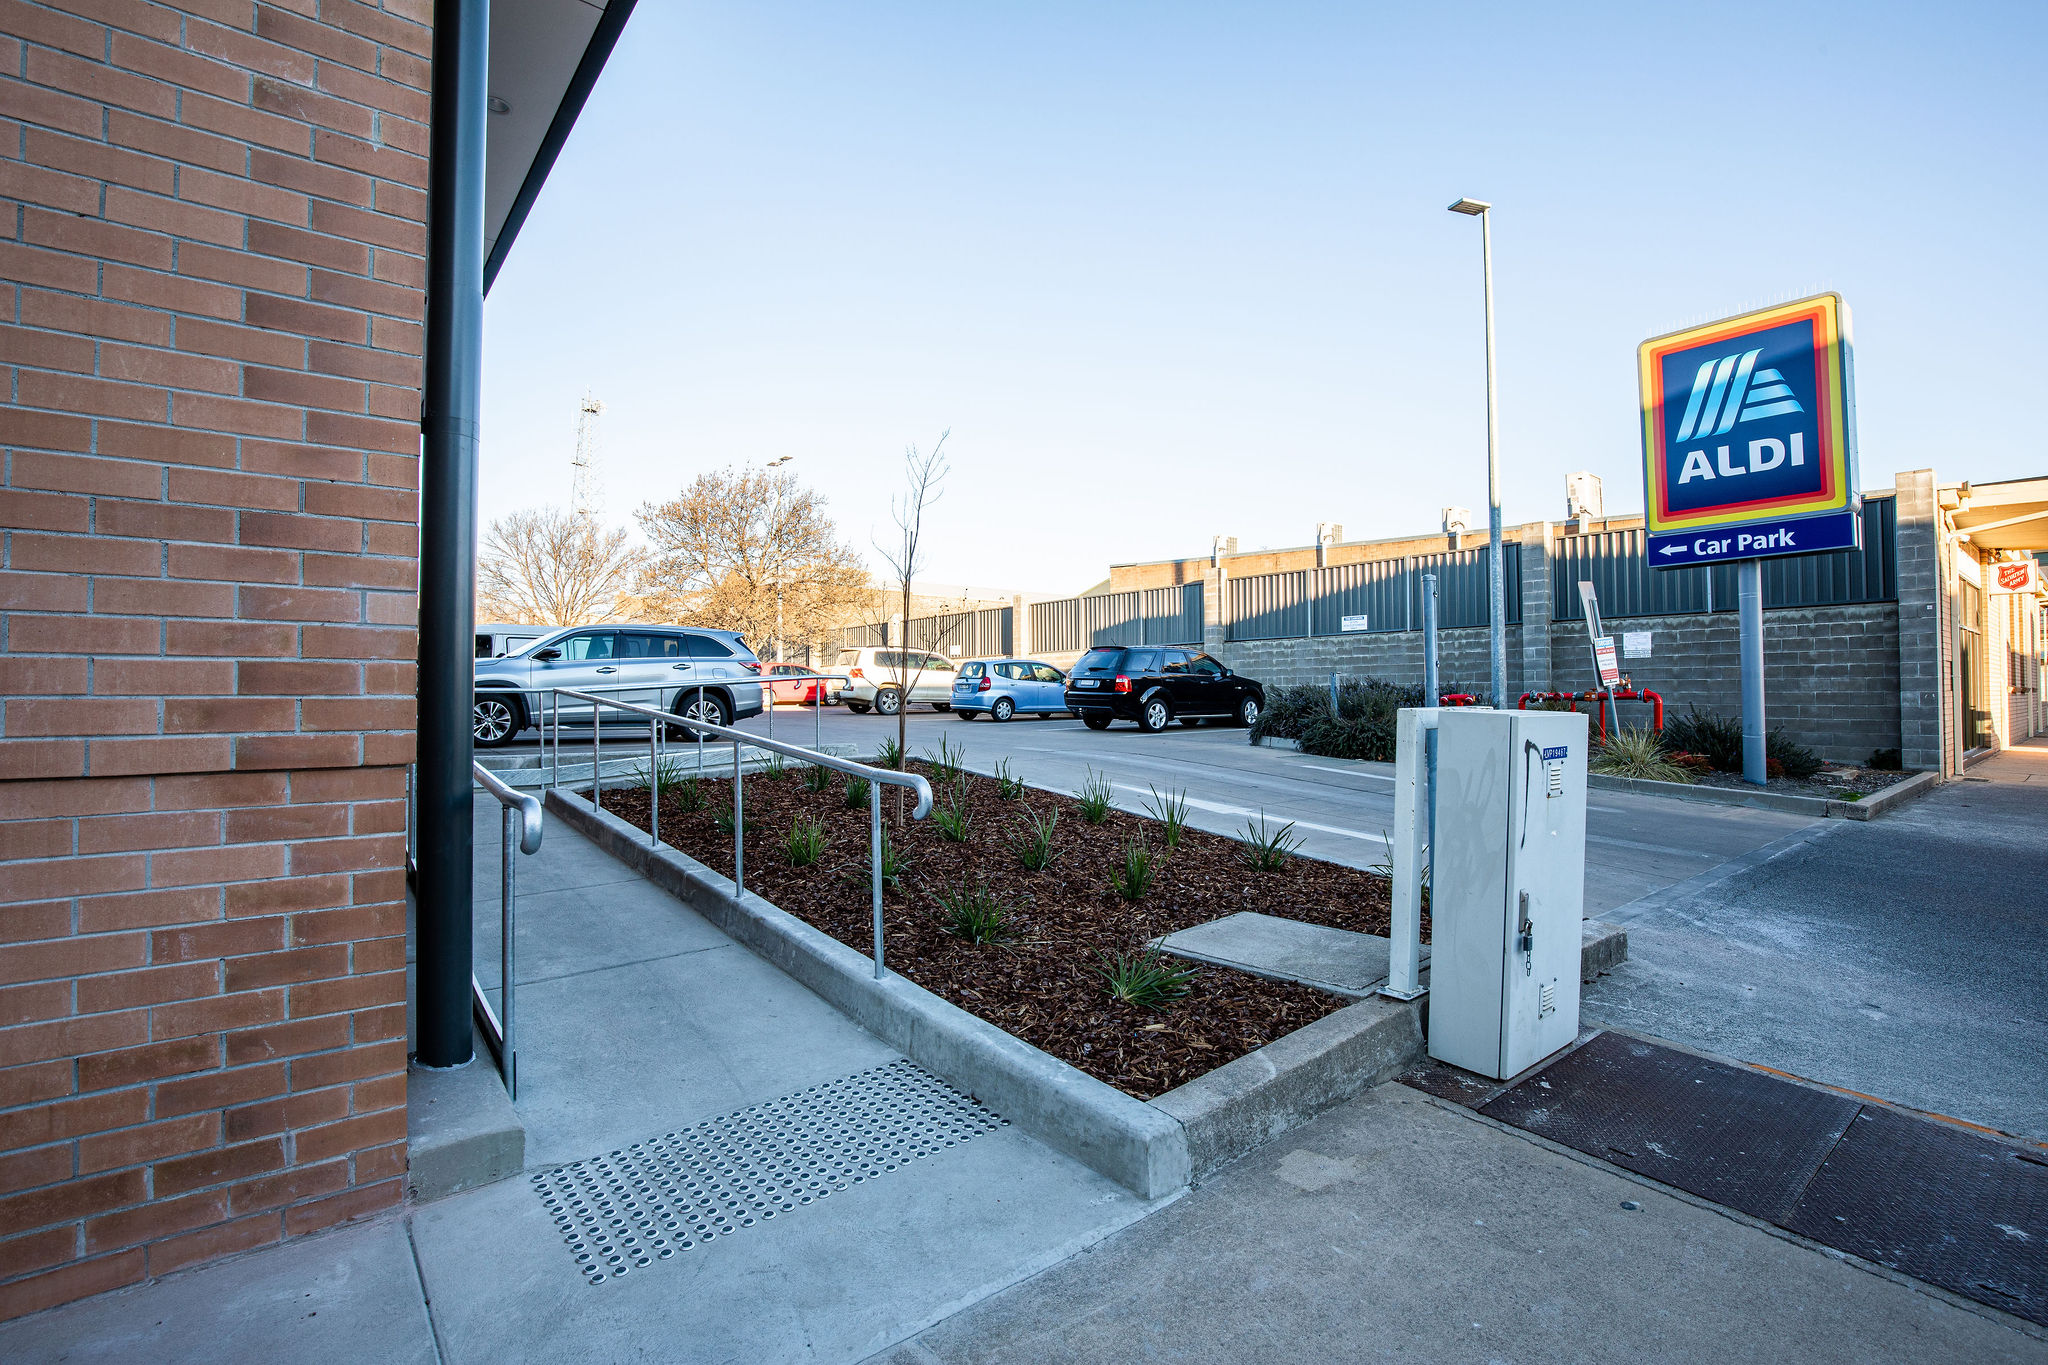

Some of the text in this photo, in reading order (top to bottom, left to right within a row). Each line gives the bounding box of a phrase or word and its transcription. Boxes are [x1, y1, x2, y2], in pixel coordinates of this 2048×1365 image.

[1678, 432, 1804, 484] ALDI
[1694, 528, 1797, 556] Car Park
[2000, 568, 2025, 584] SALVATION
[2004, 568, 2015, 576] THE
[2009, 576, 2024, 586] ARMY
